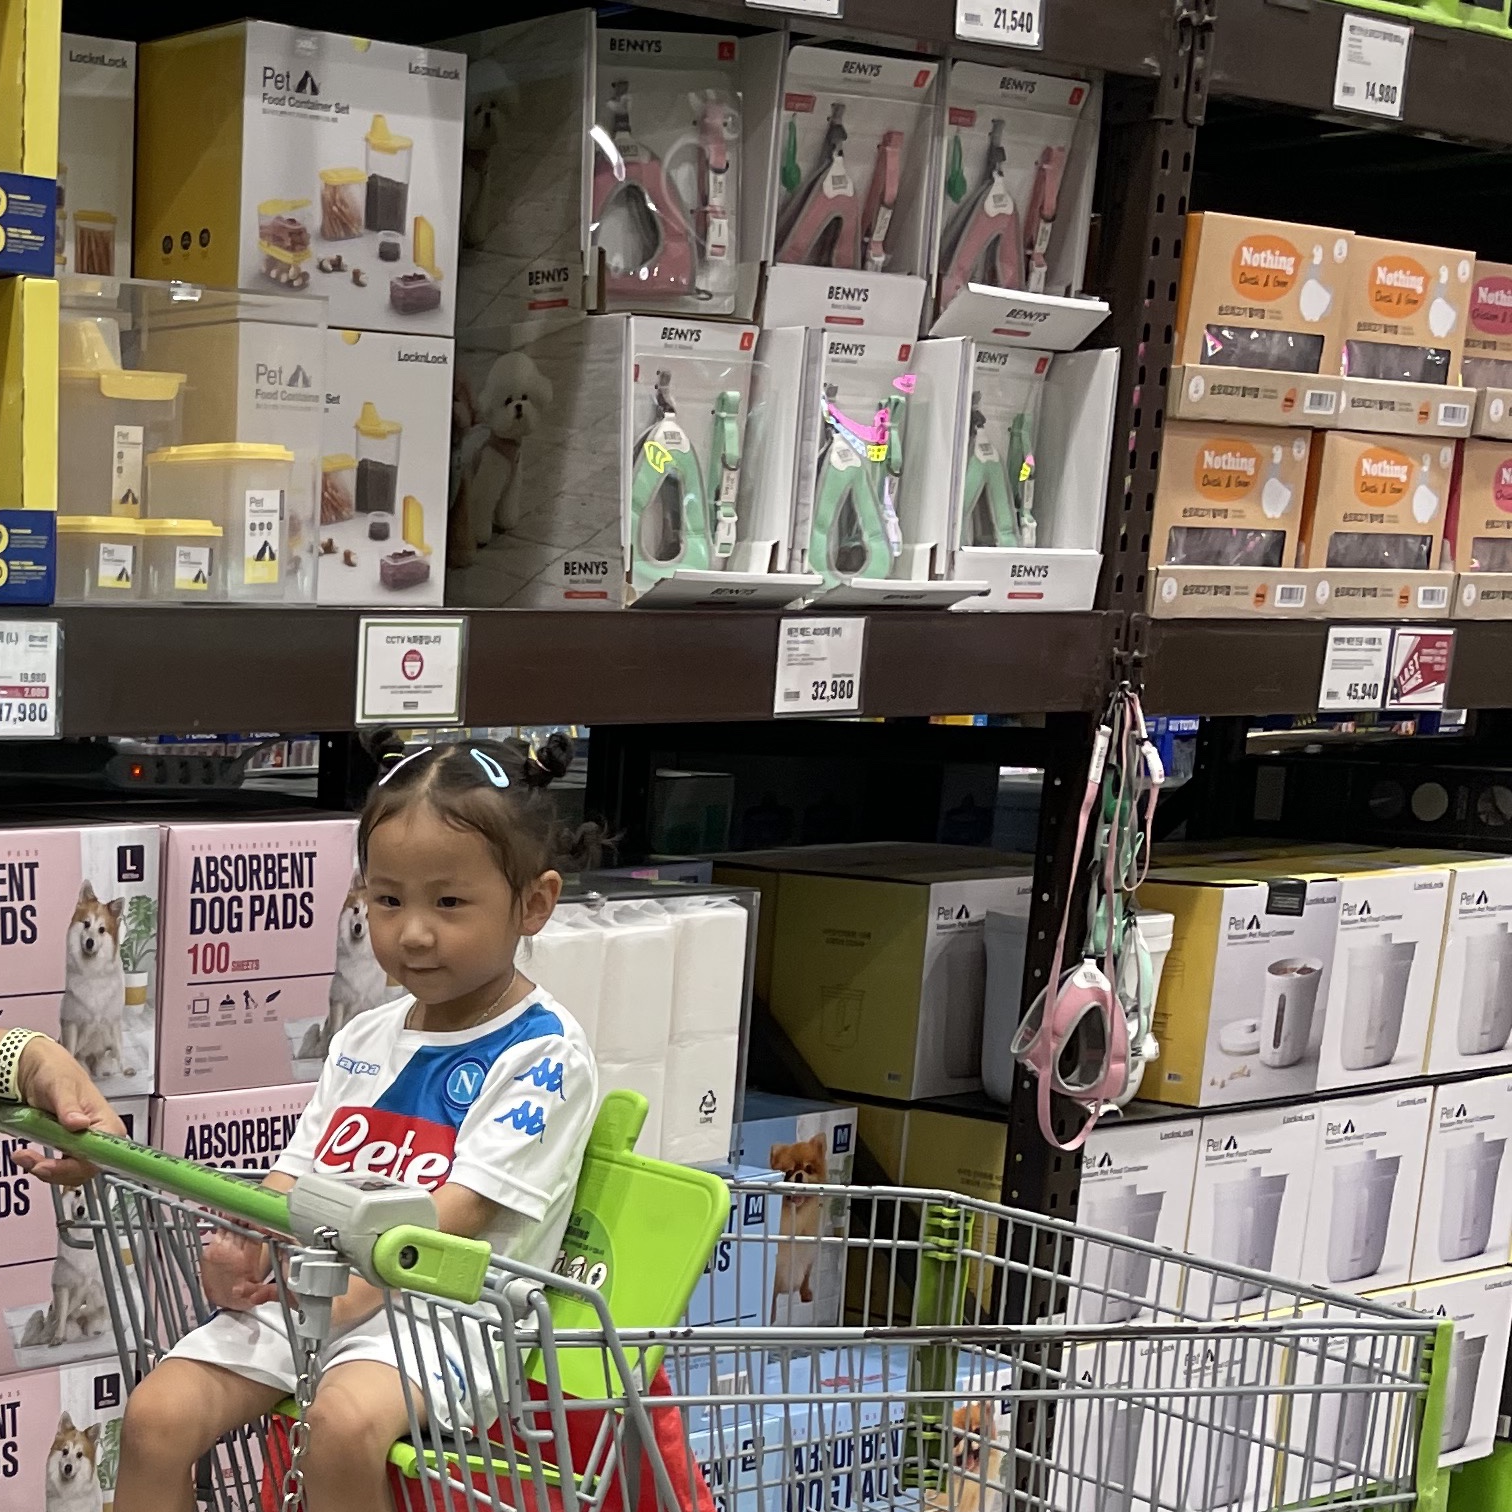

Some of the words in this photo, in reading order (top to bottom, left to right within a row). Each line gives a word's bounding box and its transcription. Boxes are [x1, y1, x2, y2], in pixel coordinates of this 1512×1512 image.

[993, 8, 1033, 34] 21,540
[609, 37, 662, 53] BENNYS
[69, 50, 128, 69] LocknLock
[842, 60, 883, 78] BENNYS
[262, 66, 291, 92] Pet
[999, 76, 1038, 95] BENNYS
[1240, 246, 1295, 275] Nothing
[528, 267, 569, 286] BENNYS
[1376, 266, 1424, 294] Nothing
[827, 286, 869, 303] BENNYS
[1478, 286, 1512, 307] Nothi
[1006, 308, 1050, 323] BENNYS
[660, 326, 702, 343] BENNYS
[398, 351, 448, 365] LocknLock
[829, 341, 866, 358] BENNYS
[976, 350, 1009, 367] BENNYS
[256, 363, 283, 386] Pet
[255, 389, 278, 401] Food
[1203, 450, 1256, 476] Nothing
[1361, 458, 1408, 482] Nothing
[563, 561, 609, 578] BENNYS
[1010, 565, 1050, 580] BENNYS
[811, 680, 854, 702] 32,980
[126, 849, 137, 872] L
[190, 852, 317, 894] ABSORBENT
[190, 896, 244, 935] DOG
[250, 892, 314, 932] PADS
[937, 906, 954, 920] Pet
[1228, 917, 1245, 931] Pet
[188, 942, 231, 975] 100
[337, 1053, 381, 1075] appa
[454, 1071, 478, 1097] N
[184, 1113, 302, 1160] ABSORBEN
[836, 1129, 850, 1145] M
[748, 1198, 763, 1216] M
[101, 1378, 113, 1398] L
